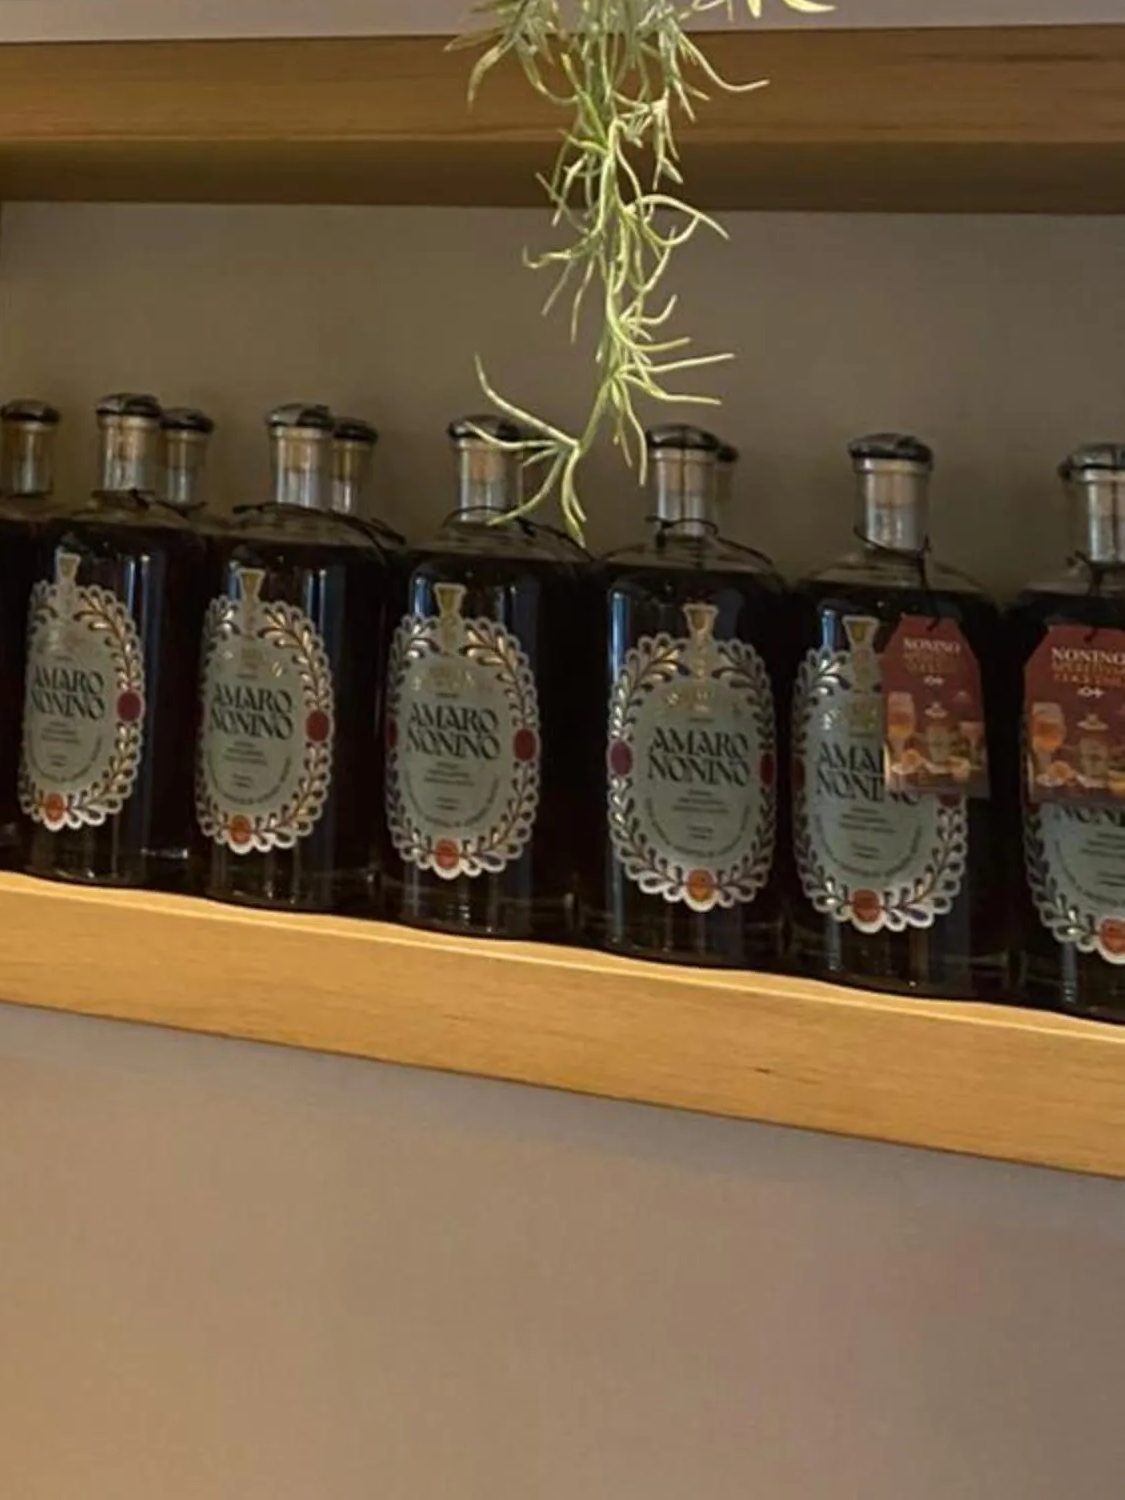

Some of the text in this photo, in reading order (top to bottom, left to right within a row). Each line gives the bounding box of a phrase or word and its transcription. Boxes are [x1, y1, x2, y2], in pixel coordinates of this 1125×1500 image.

[33, 664, 105, 695] AMARO
[30, 688, 106, 721] NONINO
[213, 681, 293, 716] AMARO
[209, 705, 295, 741] NONINO
[409, 701, 499, 735] AMARO
[406, 728, 502, 761] NONINO
[648, 726, 750, 763] AMARO
[816, 740, 885, 775] AMA
[647, 753, 751, 787] NONINO
